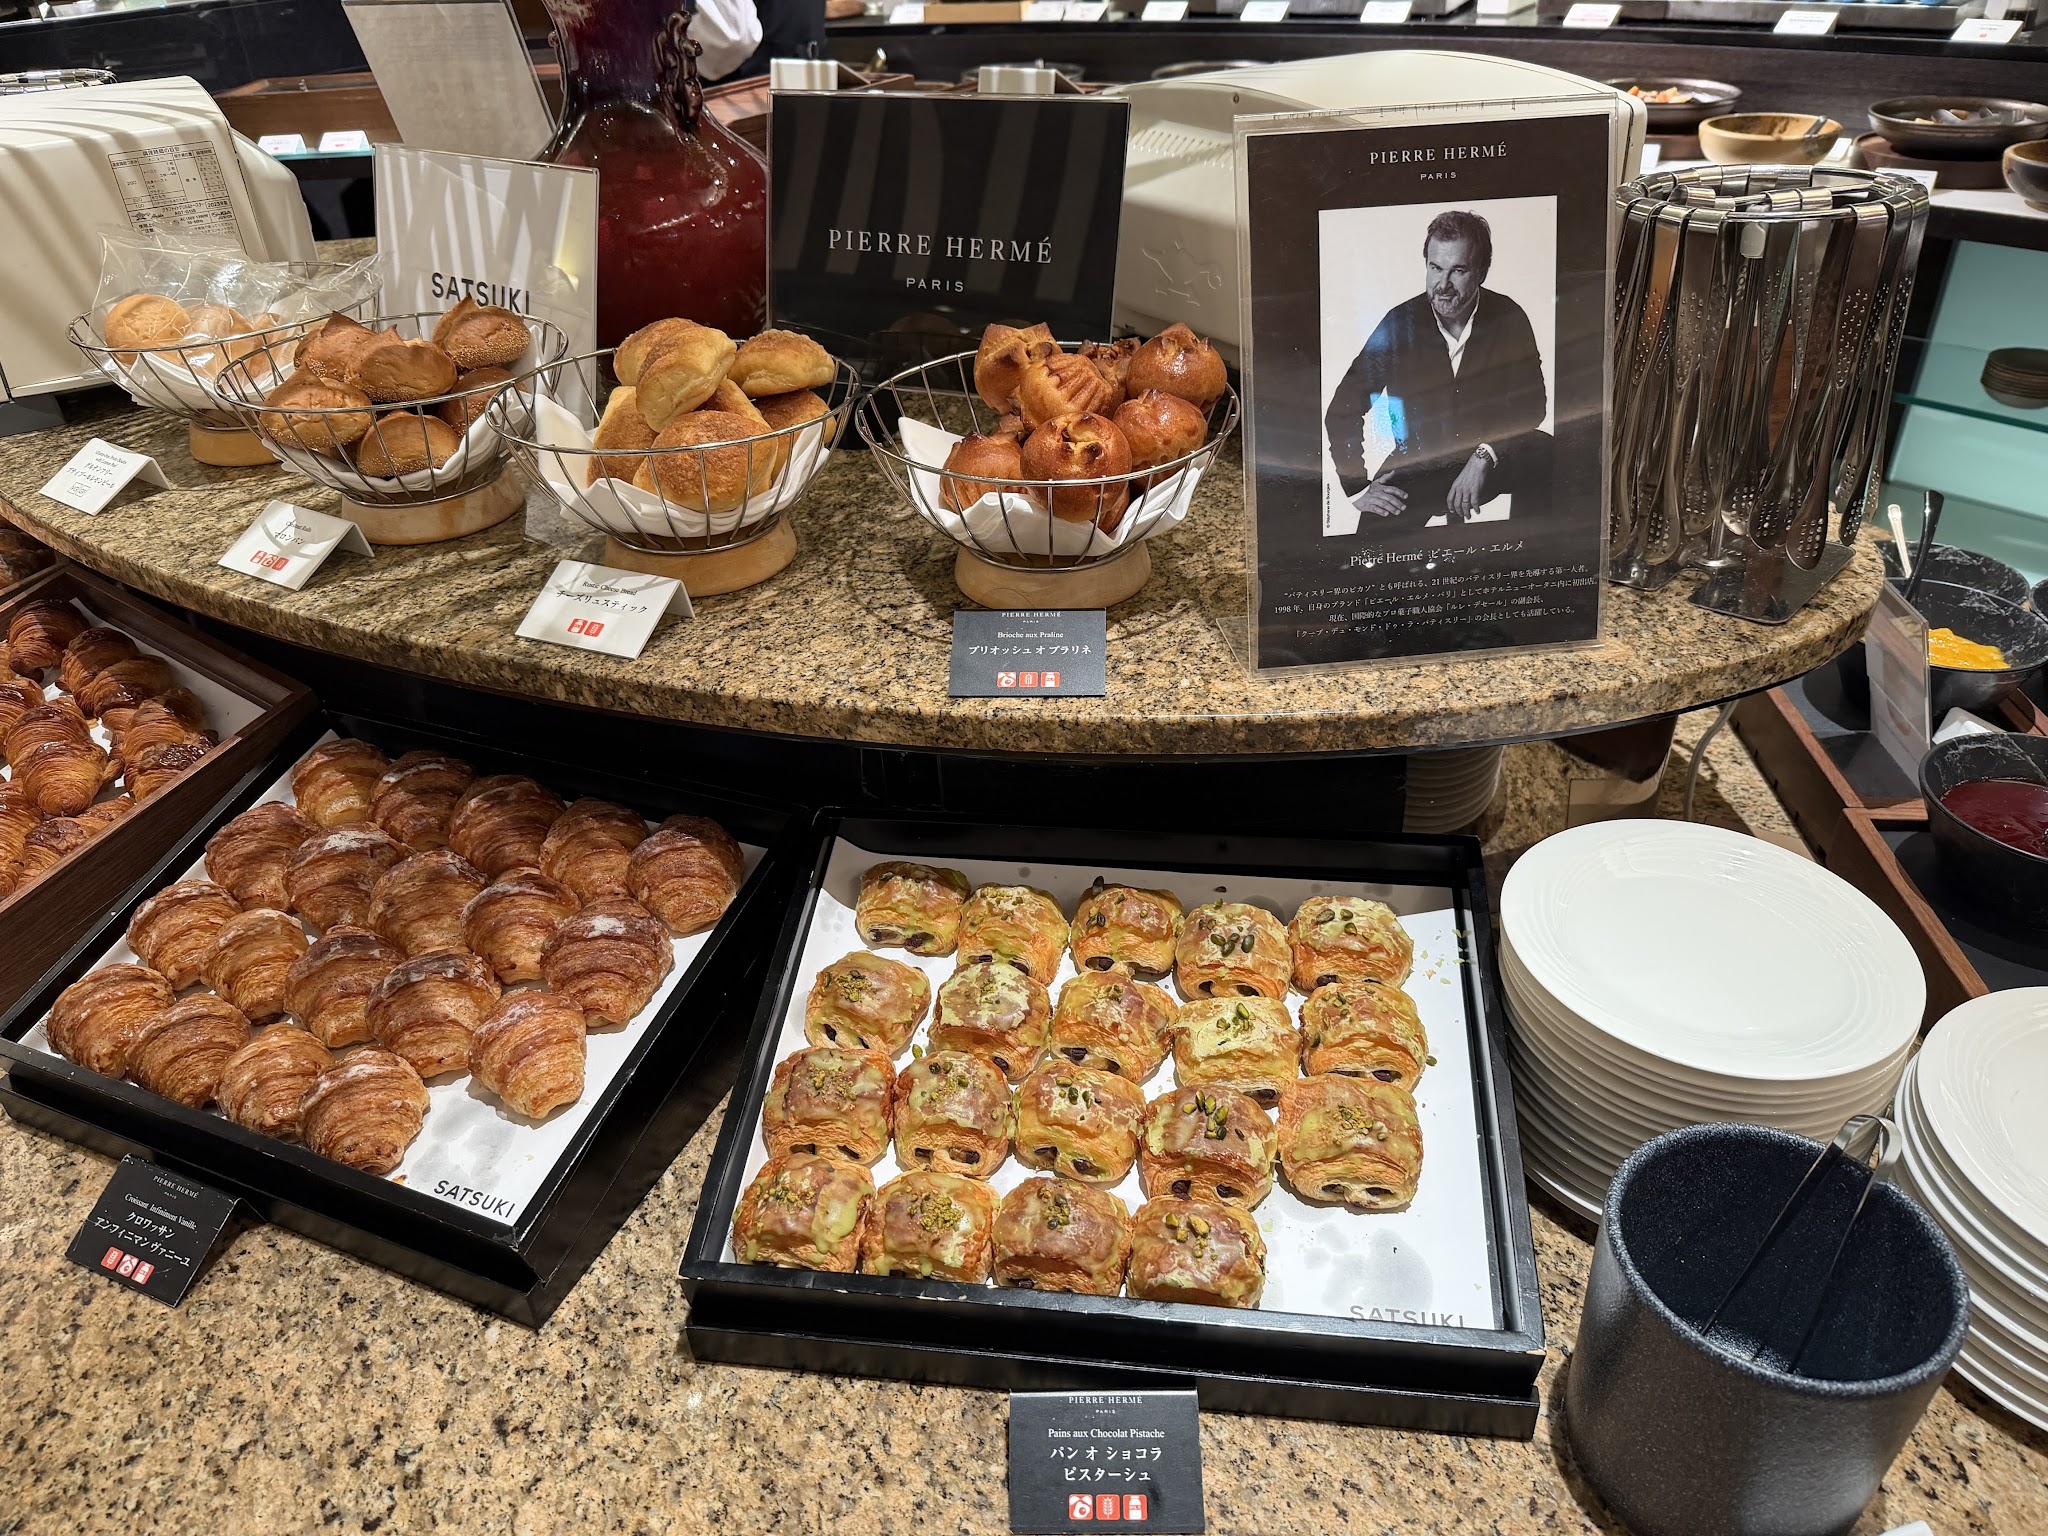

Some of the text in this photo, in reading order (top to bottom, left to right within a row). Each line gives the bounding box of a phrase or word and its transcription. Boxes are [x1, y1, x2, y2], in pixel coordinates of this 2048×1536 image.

[1370, 141, 1507, 165] PIERRE HERMÉ
[1420, 171, 1457, 181] PARIS
[828, 229, 1053, 264] PIERRE HERMÉ
[431, 272, 530, 315] SATSUKI
[905, 277, 964, 293] PARIS
[1386, 550, 1424, 564] Hermé
[556, 590, 648, 614] チーズリュスティック
[152, 1175, 200, 1199] PIERRE HERMÉ
[433, 1180, 516, 1218] SATSUKI
[124, 1192, 197, 1230] Croissant Infiniment Vanille
[125, 1211, 176, 1239] クロワッサン
[1068, 1396, 1105, 1404] PIERRE
[1048, 1428, 1071, 1438] Pains
[1090, 1429, 1128, 1438] Chocolat
[1130, 1429, 1165, 1438] Pistache
[1050, 1446, 1163, 1461] パン オ ショコラ
[1064, 1467, 1151, 1482] ピスターシュ
